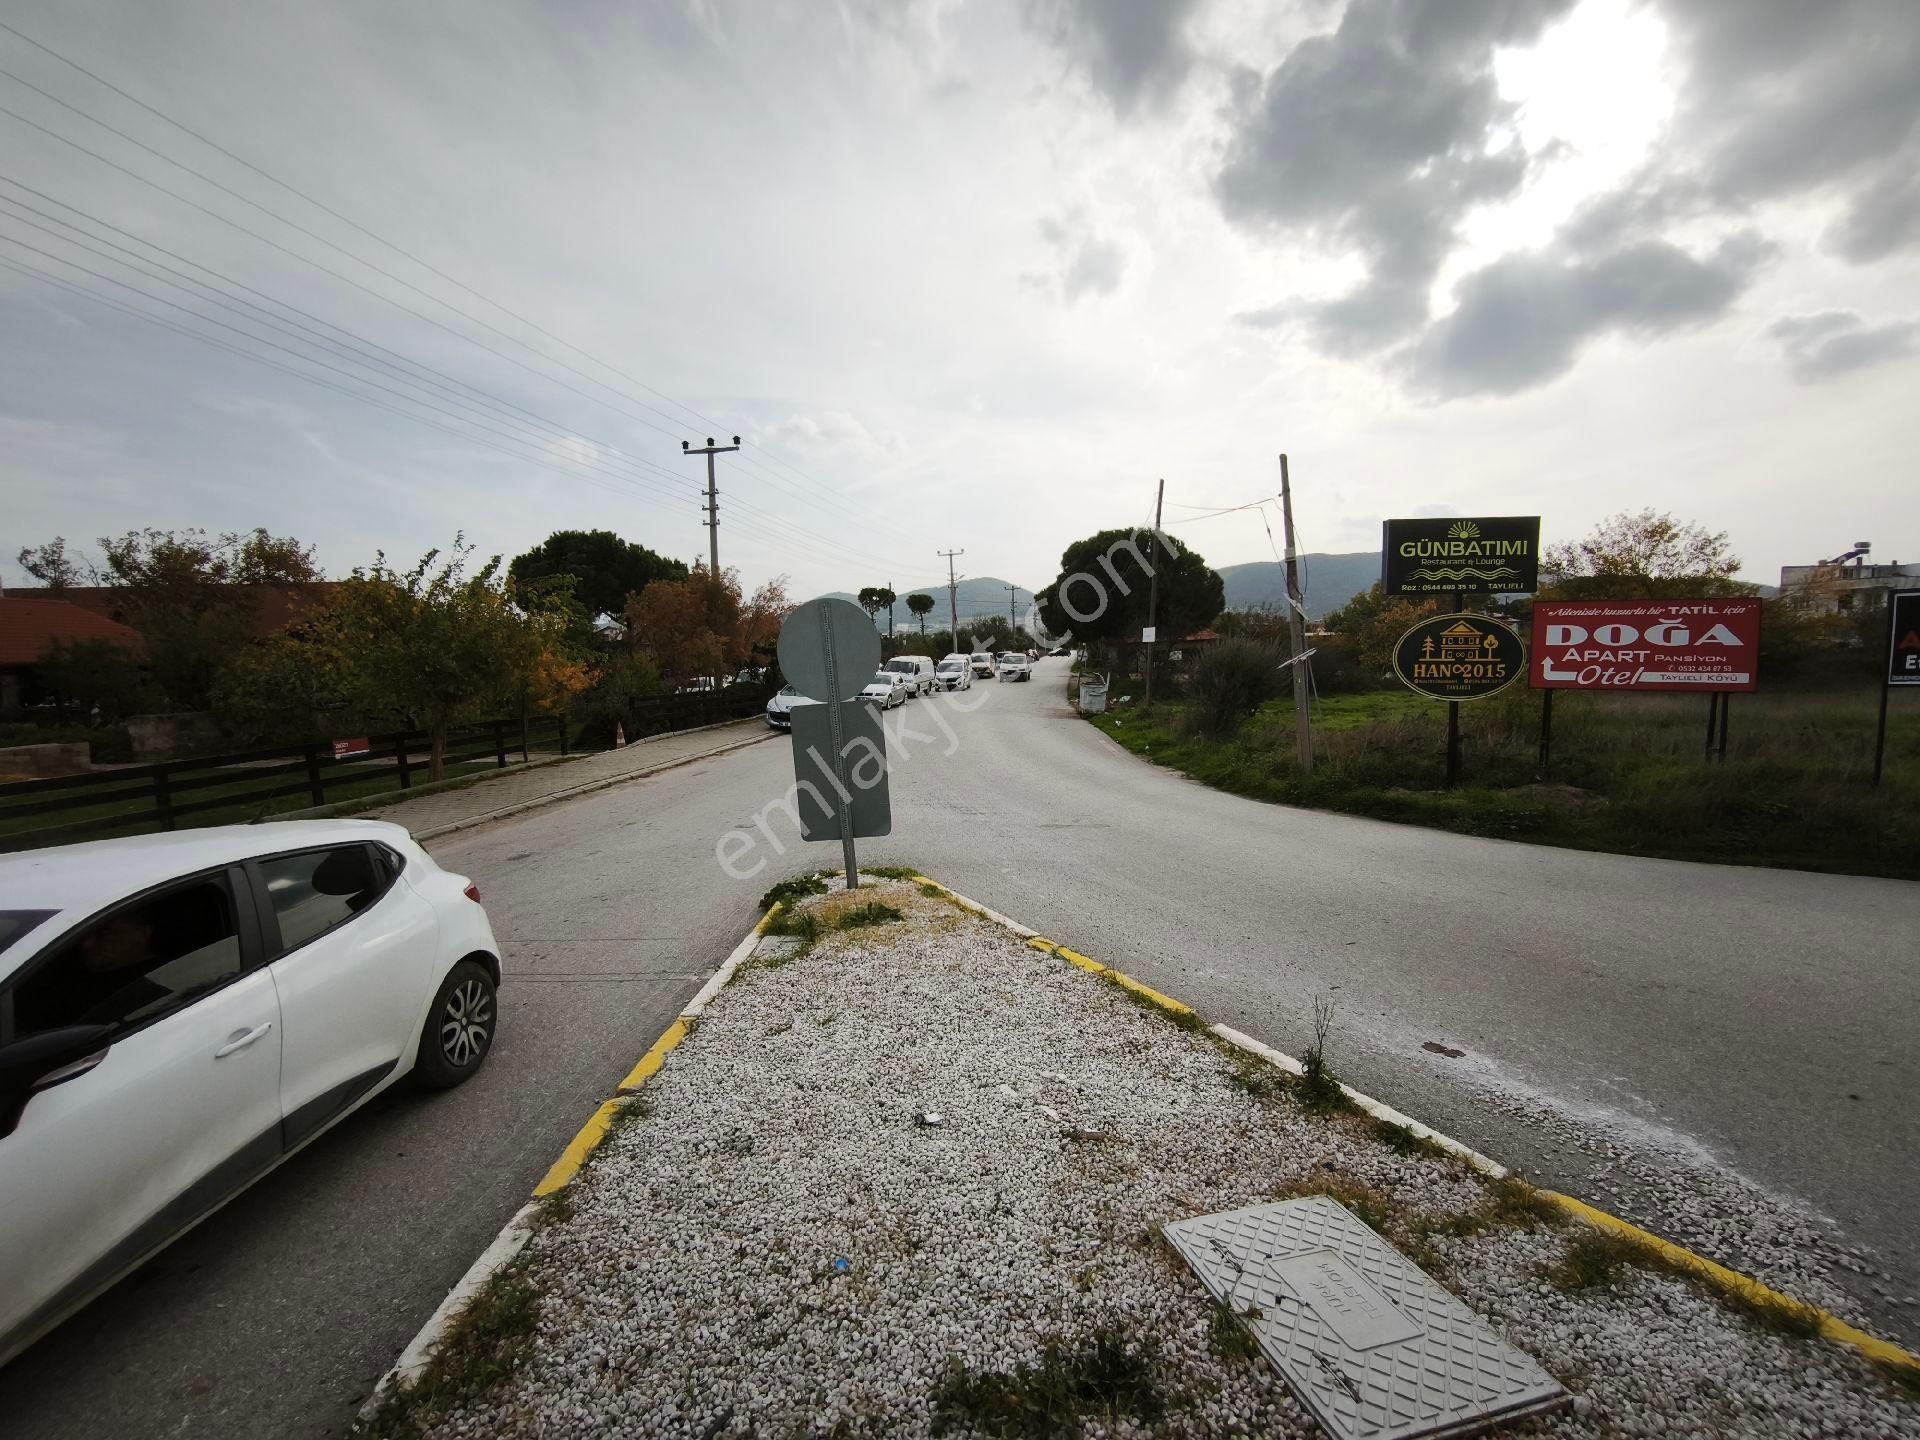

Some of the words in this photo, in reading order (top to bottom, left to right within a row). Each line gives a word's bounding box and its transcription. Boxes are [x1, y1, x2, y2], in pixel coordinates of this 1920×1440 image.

[1400, 538, 1528, 557] GÜNBATIMI
[1421, 558, 1466, 566] Restaurant
[1475, 558, 1506, 566] Lounge
[1668, 604, 1719, 615] TATİL
[1545, 617, 1745, 647] DOĞA
[1561, 647, 1651, 663] APART
[1577, 664, 1645, 685] Otel
